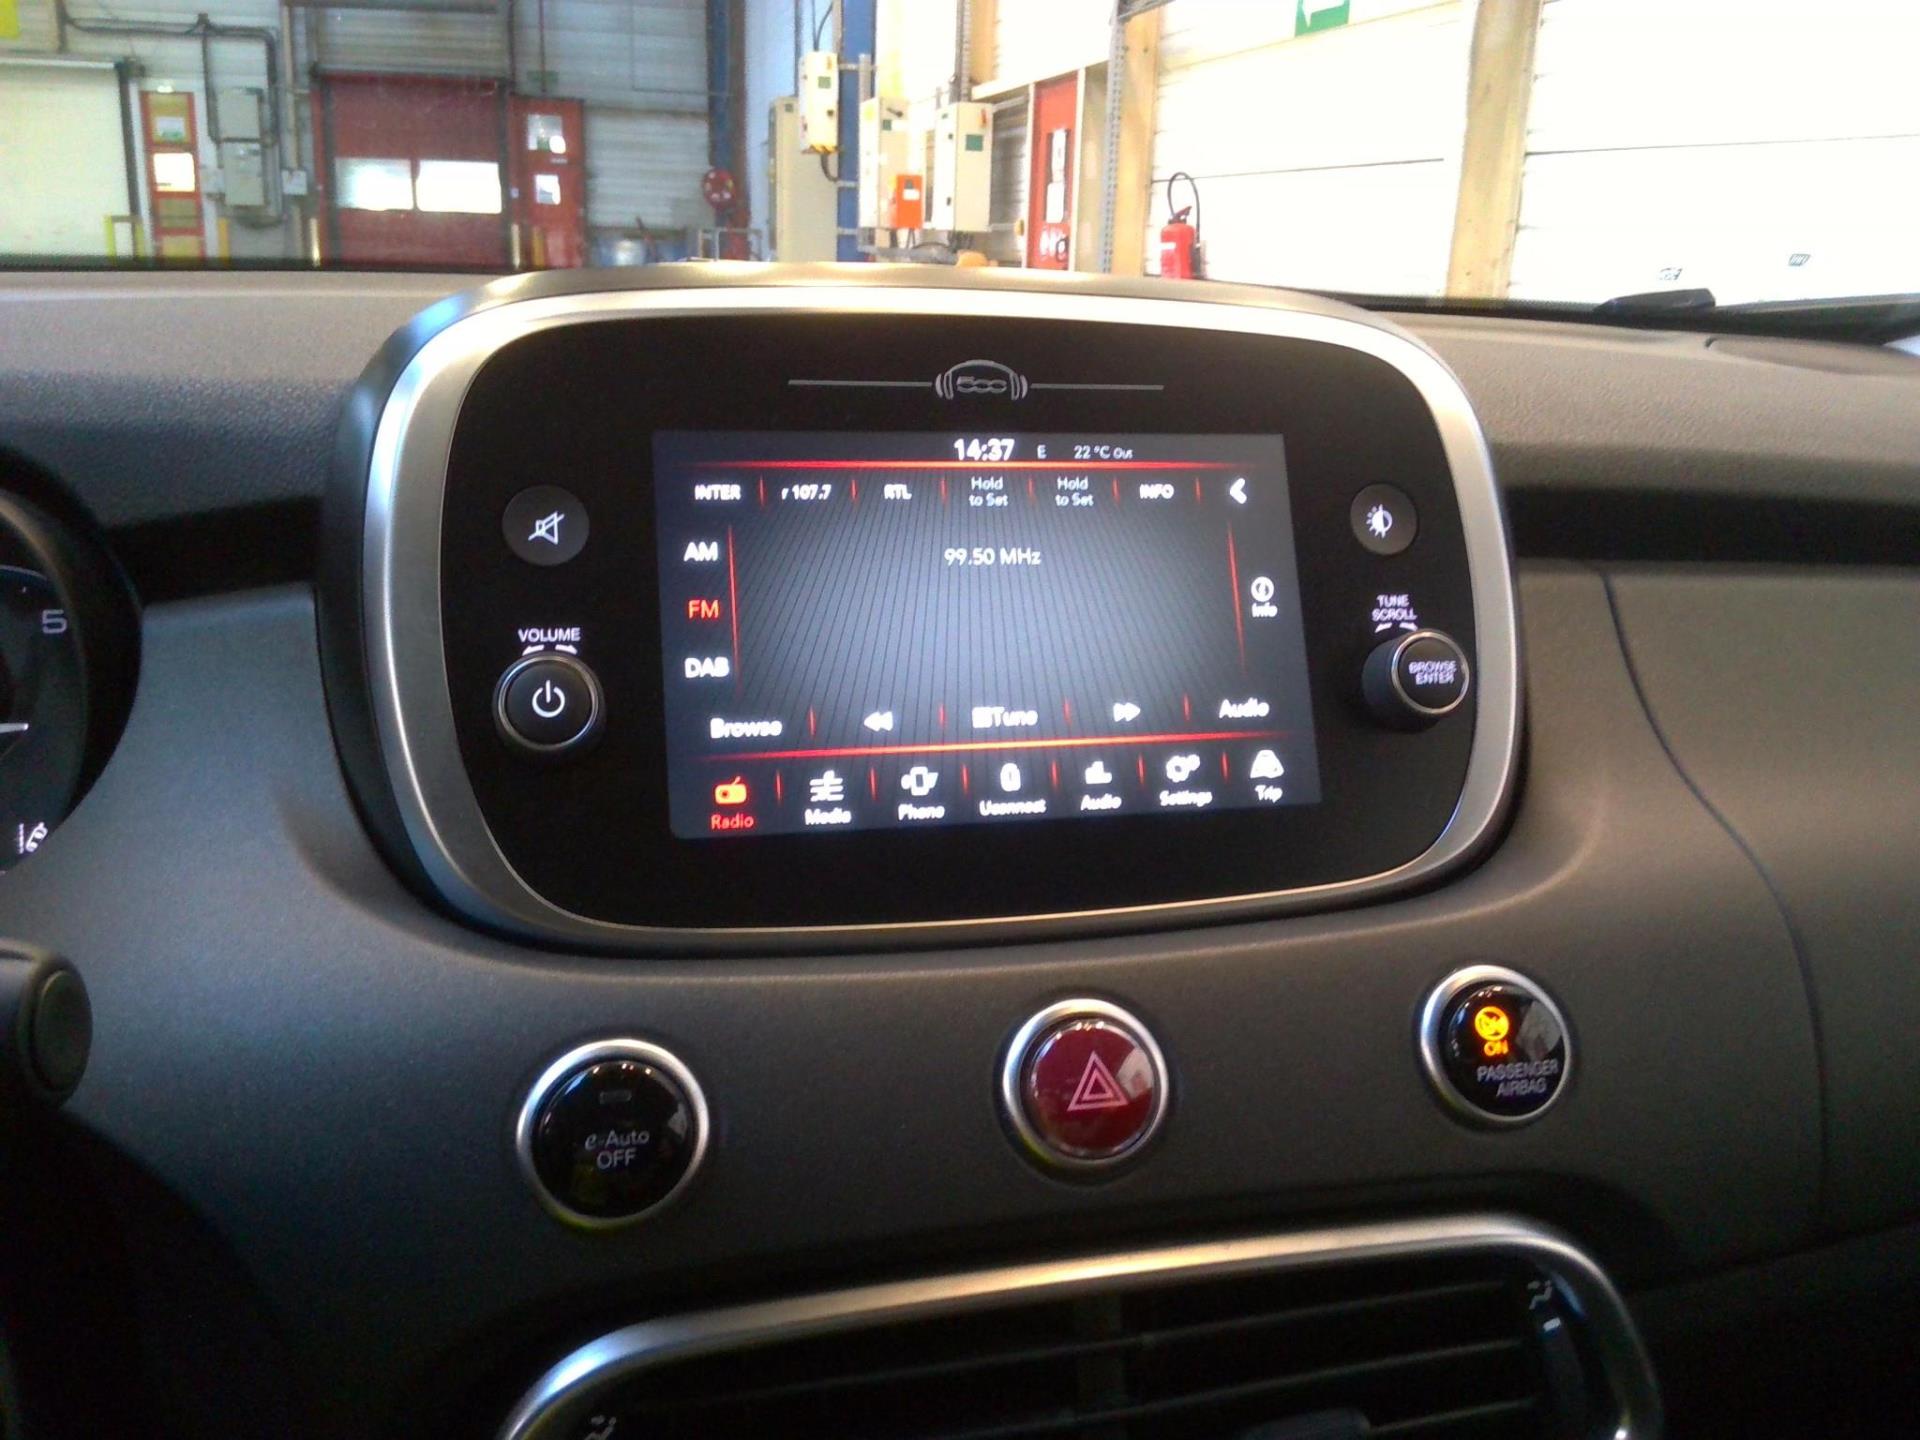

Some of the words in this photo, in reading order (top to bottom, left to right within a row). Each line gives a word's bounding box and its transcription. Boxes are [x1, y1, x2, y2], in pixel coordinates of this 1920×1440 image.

[953, 438, 1015, 461] 14:37
[1036, 444, 1048, 460] E
[1073, 445, 1091, 460] 22
[694, 484, 742, 501] INTER
[792, 484, 832, 500] 107.7
[883, 484, 913, 500] RTL
[970, 476, 1004, 491] Hold
[1056, 476, 1089, 491] Hold
[1139, 483, 1175, 500] INFO
[968, 494, 983, 507] to
[1055, 494, 1069, 507] to
[683, 541, 718, 562] AM
[944, 547, 995, 566] 99.50
[1000, 547, 1042, 566] MHz
[687, 599, 719, 620] FM
[1376, 594, 1410, 608] TUNE
[41, 608, 68, 634] 5
[1371, 608, 1418, 623] SCROLL
[517, 627, 581, 644] VOLUME
[684, 656, 730, 679] DAB
[1408, 659, 1457, 675] BROWSE
[1415, 671, 1455, 686] ENTER
[990, 706, 1038, 726] Tune
[1218, 697, 1270, 719] Audio
[710, 717, 783, 738] Browse
[1080, 793, 1122, 811] Audio
[1255, 784, 1283, 804] Trip
[804, 807, 852, 825] Media
[897, 803, 945, 821] Phone
[710, 813, 755, 831] Radio
[1476, 1059, 1559, 1083] PASSENGER
[1495, 1077, 1548, 1098] AIRBAG
[596, 1149, 637, 1170] OFF
